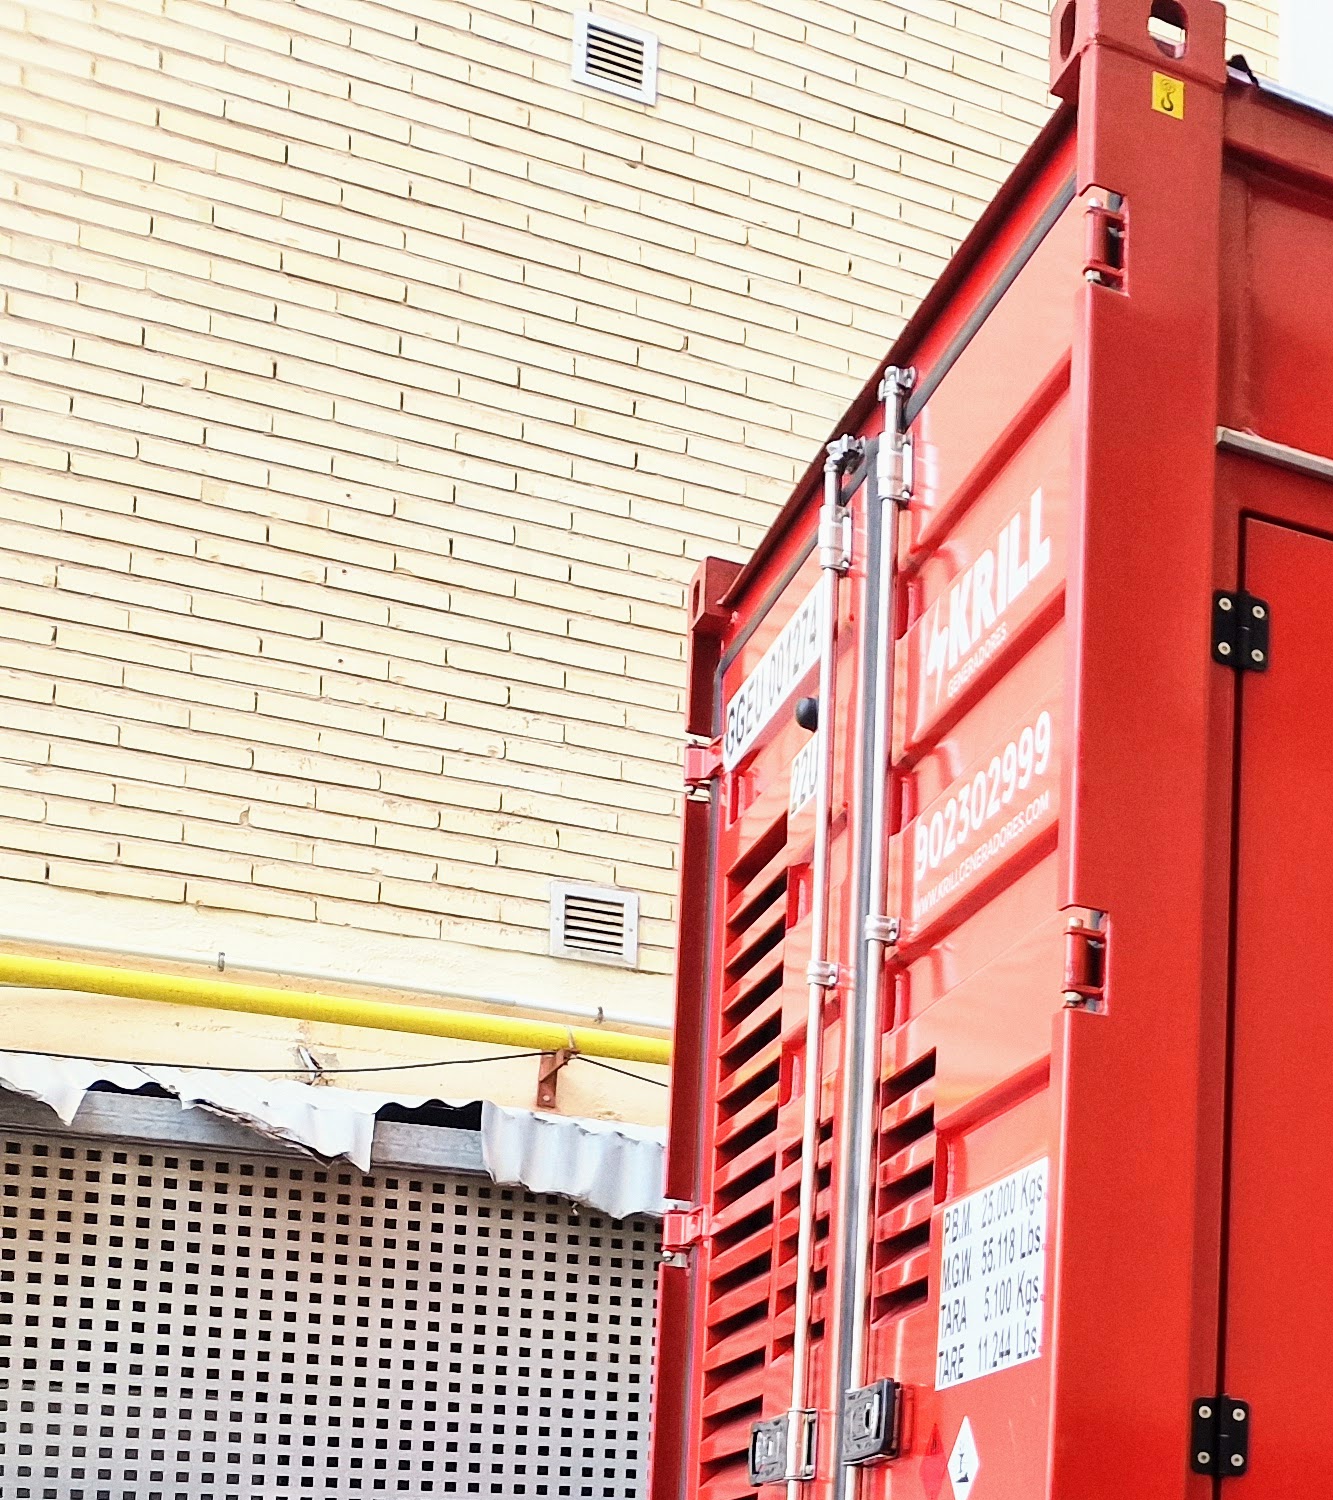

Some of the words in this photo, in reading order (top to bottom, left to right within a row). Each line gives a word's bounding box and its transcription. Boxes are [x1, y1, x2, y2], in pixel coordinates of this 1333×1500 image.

[948, 486, 1050, 669] KRILL
[725, 670, 765, 758] GGEU
[790, 738, 818, 815] 22U
[914, 710, 1051, 881] 902302999
[913, 789, 1051, 918] WWW.KRILLGENERADORES.COM
[944, 1201, 973, 1247] P.B.M.
[981, 1178, 1017, 1229] 25.000
[942, 1247, 973, 1292] M.G.W.
[981, 1229, 1016, 1276] 55.118
[941, 1296, 967, 1339] TARA
[983, 1277, 1012, 1322] 5.100
[938, 1344, 965, 1386] TARE
[978, 1326, 1011, 1373] 11.244
